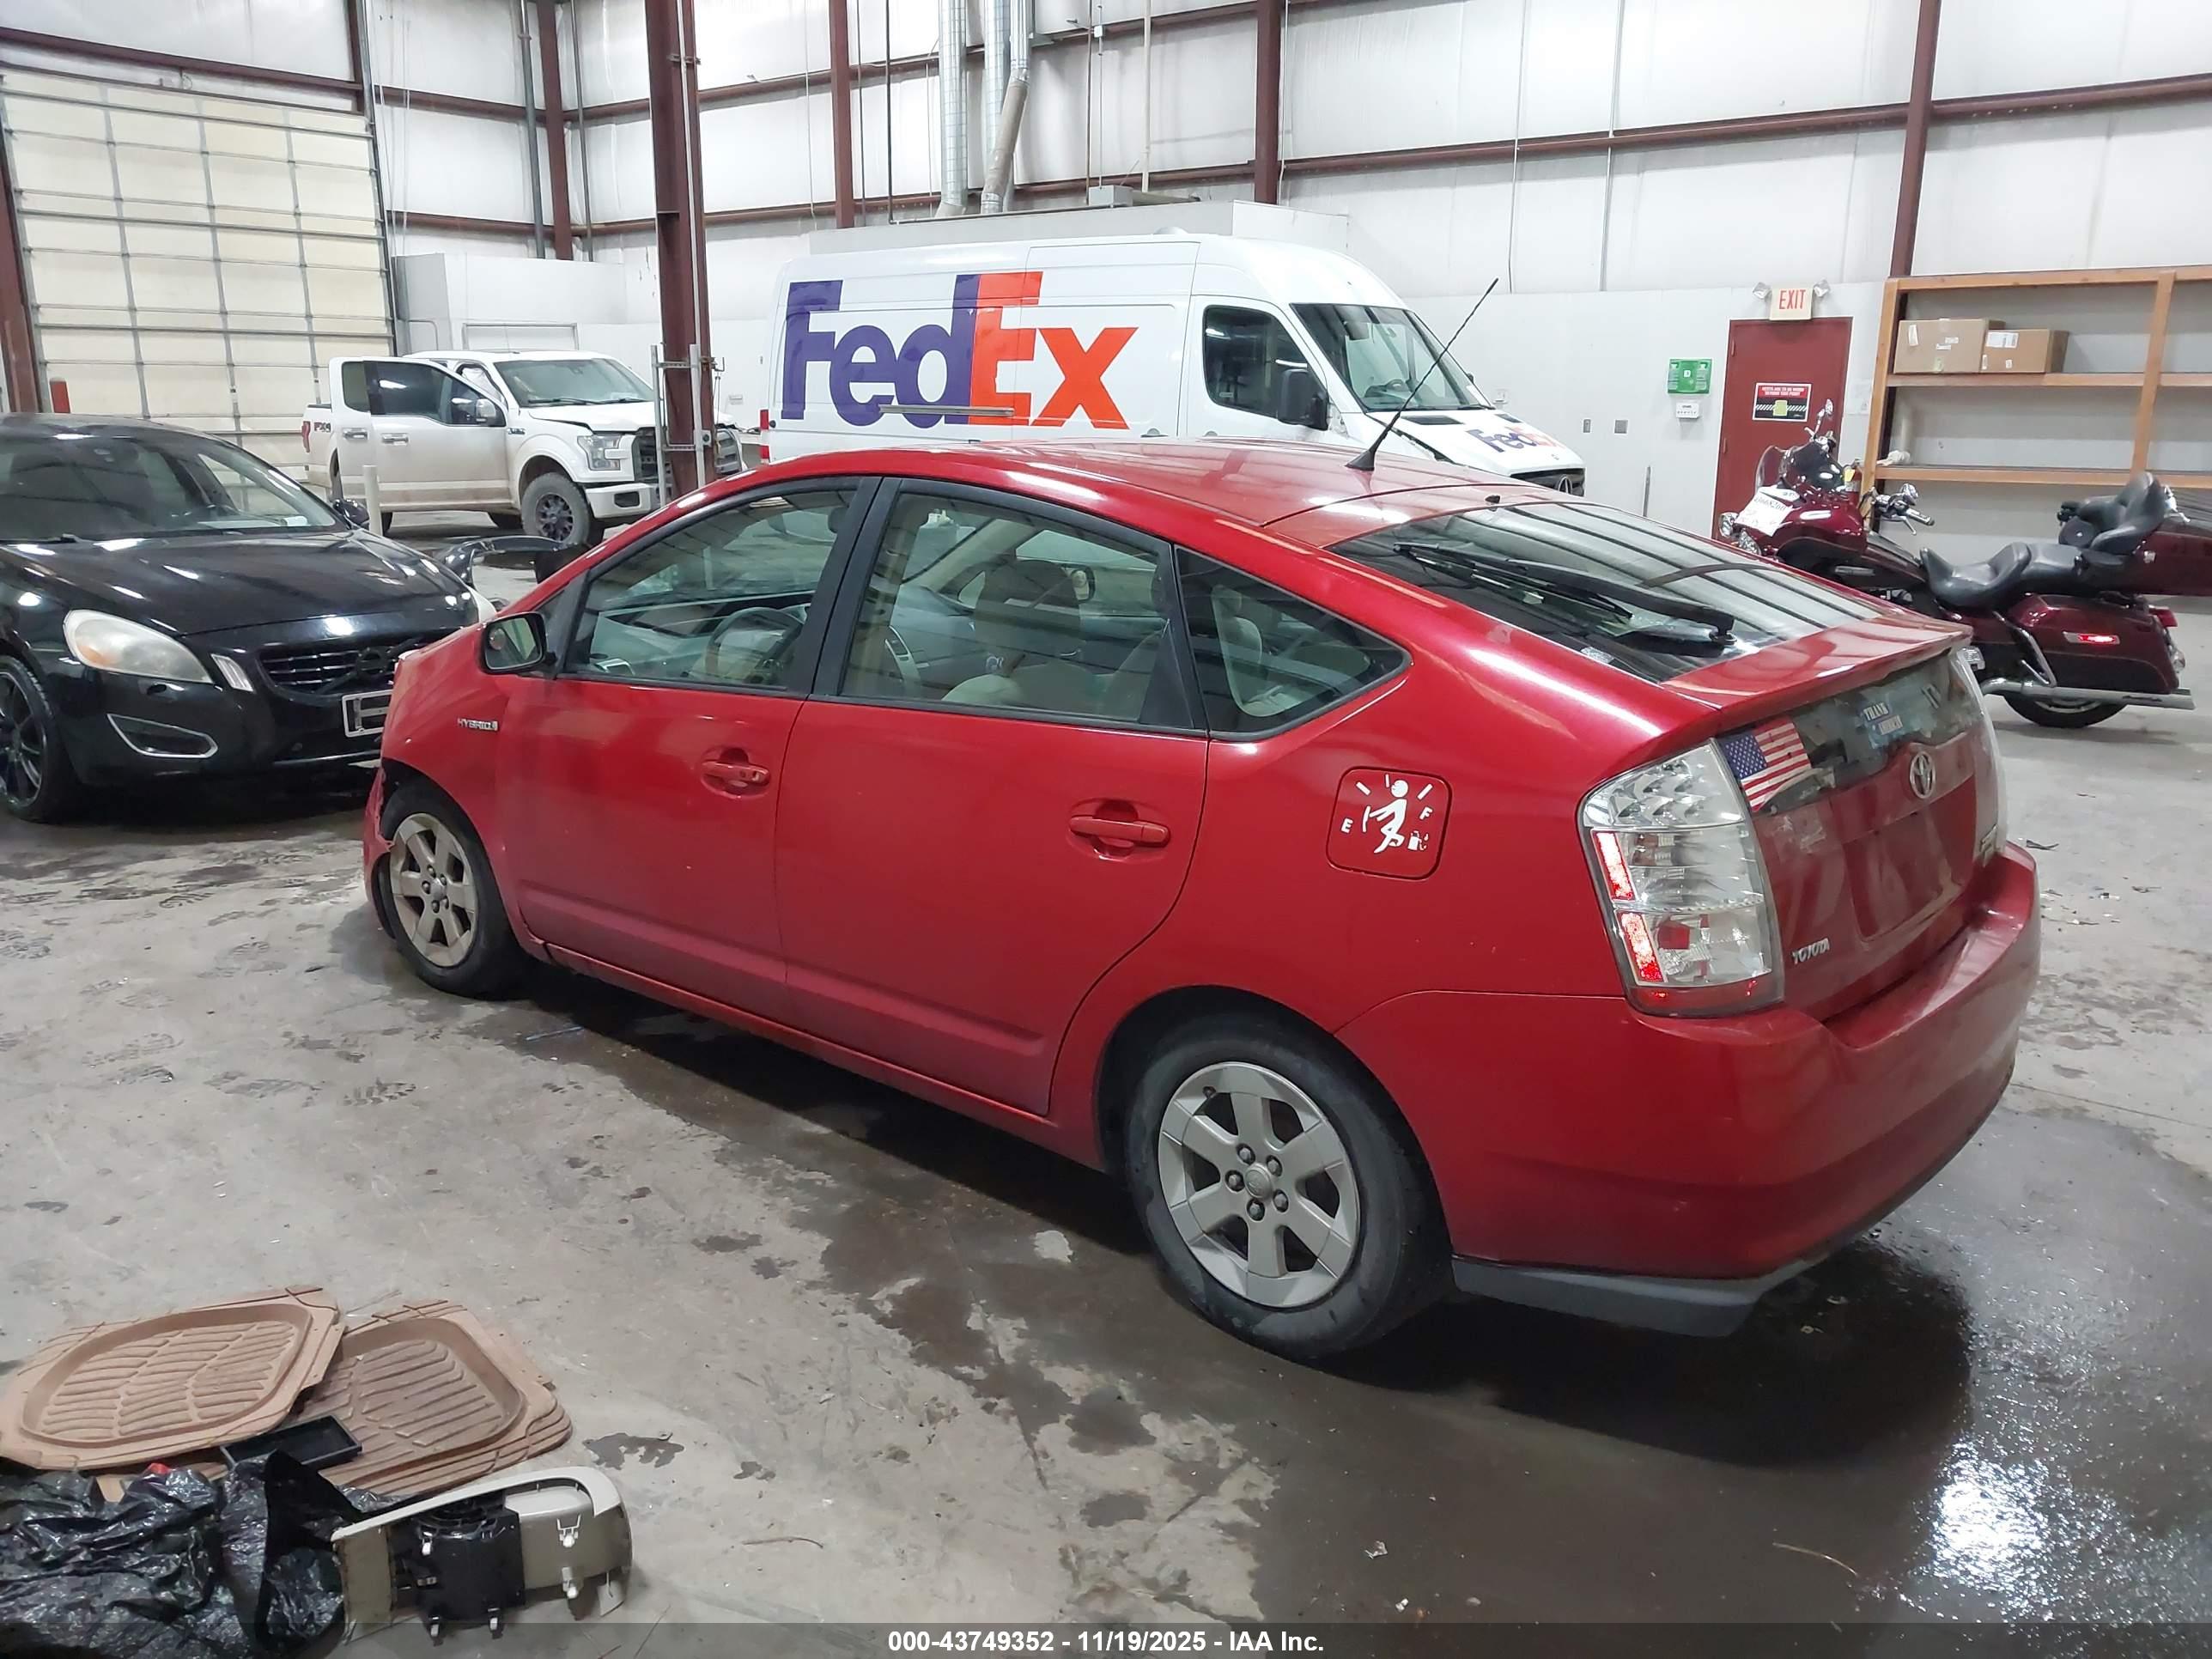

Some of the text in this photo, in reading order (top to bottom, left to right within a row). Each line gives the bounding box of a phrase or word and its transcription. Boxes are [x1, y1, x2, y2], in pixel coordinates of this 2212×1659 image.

[1778, 289, 1807, 310] EXIT
[781, 270, 1139, 429] FedEx
[1419, 806, 1432, 820] F
[1340, 817, 1353, 833] E
[1792, 937, 1831, 965] TOYOTA
